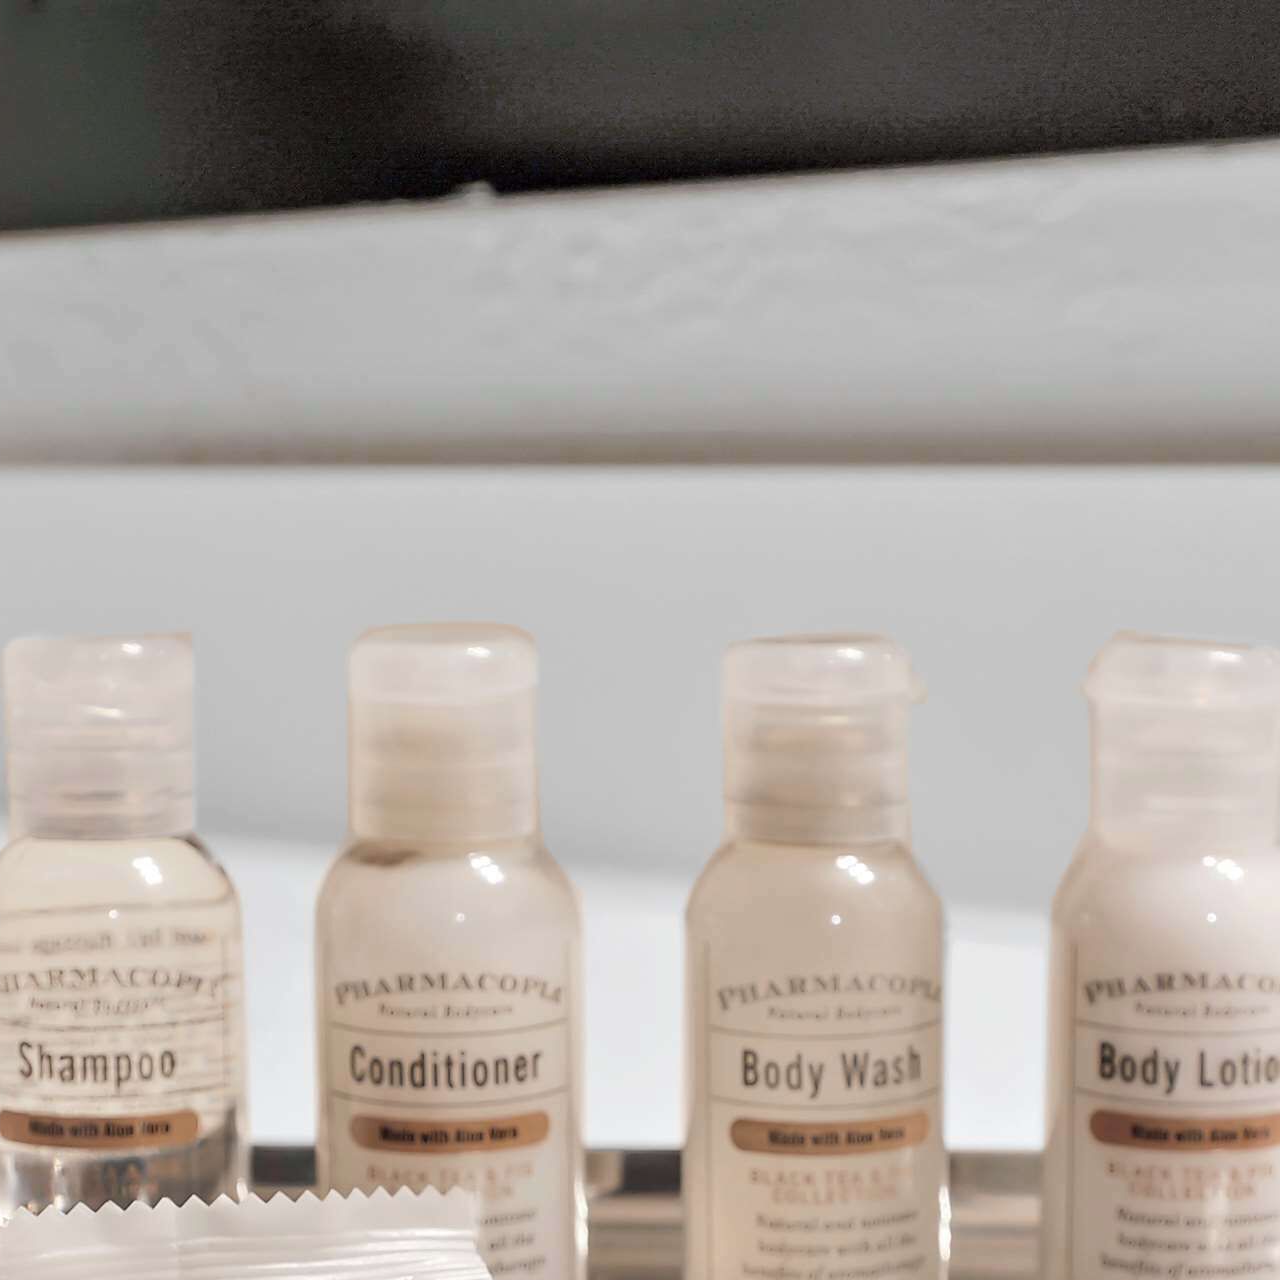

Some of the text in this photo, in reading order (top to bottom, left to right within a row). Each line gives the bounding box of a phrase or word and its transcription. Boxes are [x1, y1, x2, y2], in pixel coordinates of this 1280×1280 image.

[18, 1041, 176, 1088] Shampoo
[349, 1044, 542, 1088] Conditioner
[742, 1045, 921, 1098] Body Wash
[1099, 1041, 1180, 1094] Body
